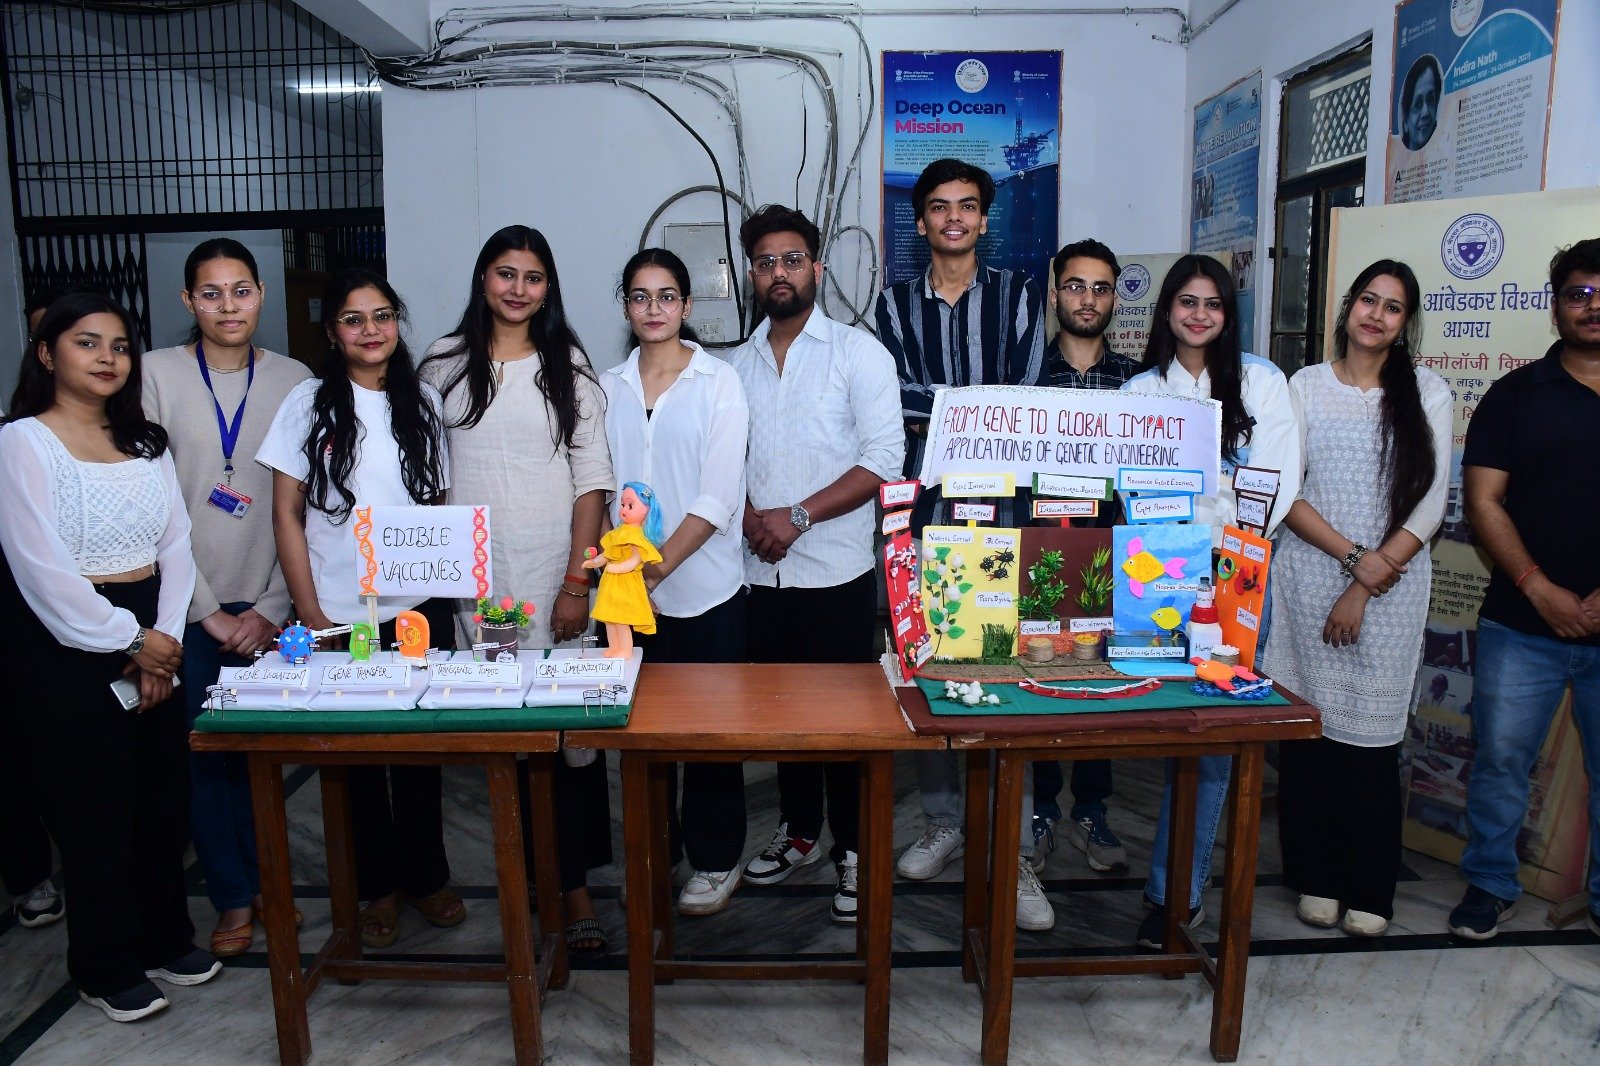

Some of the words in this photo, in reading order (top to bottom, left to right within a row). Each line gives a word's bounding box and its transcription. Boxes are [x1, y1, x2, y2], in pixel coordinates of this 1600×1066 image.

[1454, 60, 1476, 77] Indira
[1478, 50, 1498, 67] Nath
[896, 100, 944, 117] Deep
[948, 100, 1006, 114] Ocean
[895, 118, 964, 134] Mission
[1216, 117, 1257, 148] REVOLUTION
[1424, 285, 1496, 312] आंबेडकर
[1117, 320, 1144, 328] आगरा
[1444, 320, 1491, 338] आगरा
[1120, 331, 1130, 340] of
[1413, 351, 1490, 370] टेक्नोलॉजी
[1456, 378, 1484, 389] लाइफ
[943, 405, 980, 434] FROM
[983, 406, 1022, 434] GENE
[1028, 408, 1048, 435] TO
[1058, 410, 1115, 438] GLOBAL
[1117, 413, 1186, 441] IMPACT
[943, 437, 1032, 462] APPLICATIONS
[1036, 440, 1052, 463] OF
[1056, 442, 1096, 466] GENETIC
[1104, 443, 1180, 468] ENGINEERING
[383, 527, 451, 548] EDIBLE
[380, 558, 462, 588] VACCINES
